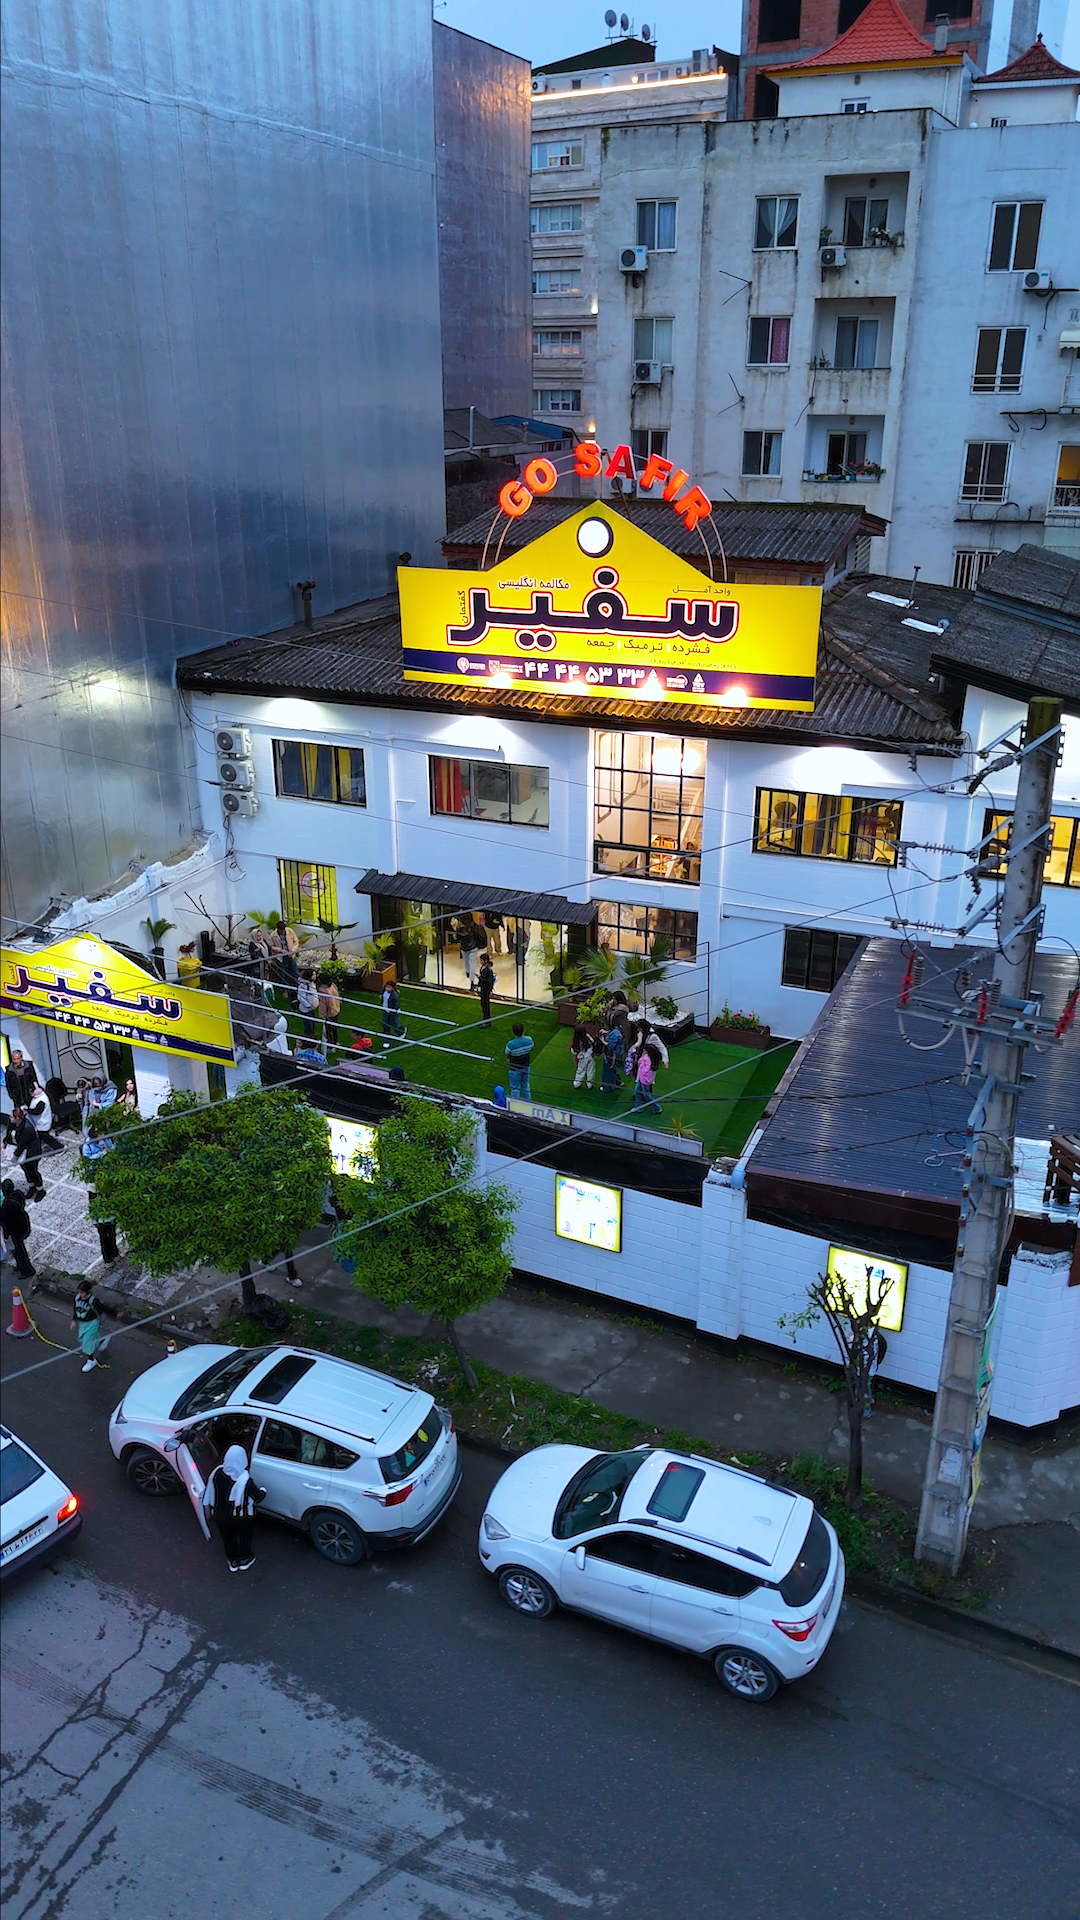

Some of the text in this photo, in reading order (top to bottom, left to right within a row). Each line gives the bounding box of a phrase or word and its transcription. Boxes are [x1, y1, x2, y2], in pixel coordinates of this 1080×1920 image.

[500, 442, 712, 532] GO SAFIR
[498, 576, 570, 590] مکالمه انگلیسی
[447, 567, 739, 652] سفیر
[586, 638, 711, 656] فشرده ترمیک جمعه
[524, 661, 549, 678] ۴۴
[554, 663, 581, 681] ۴۴
[585, 665, 613, 683] ۵۳
[617, 667, 645, 685] ۳۳
[4, 965, 183, 1021] سفیر
[74, 1015, 90, 1027] ۴۴
[93, 1020, 111, 1032] ۵۳
[112, 1024, 131, 1036] ۳۳
